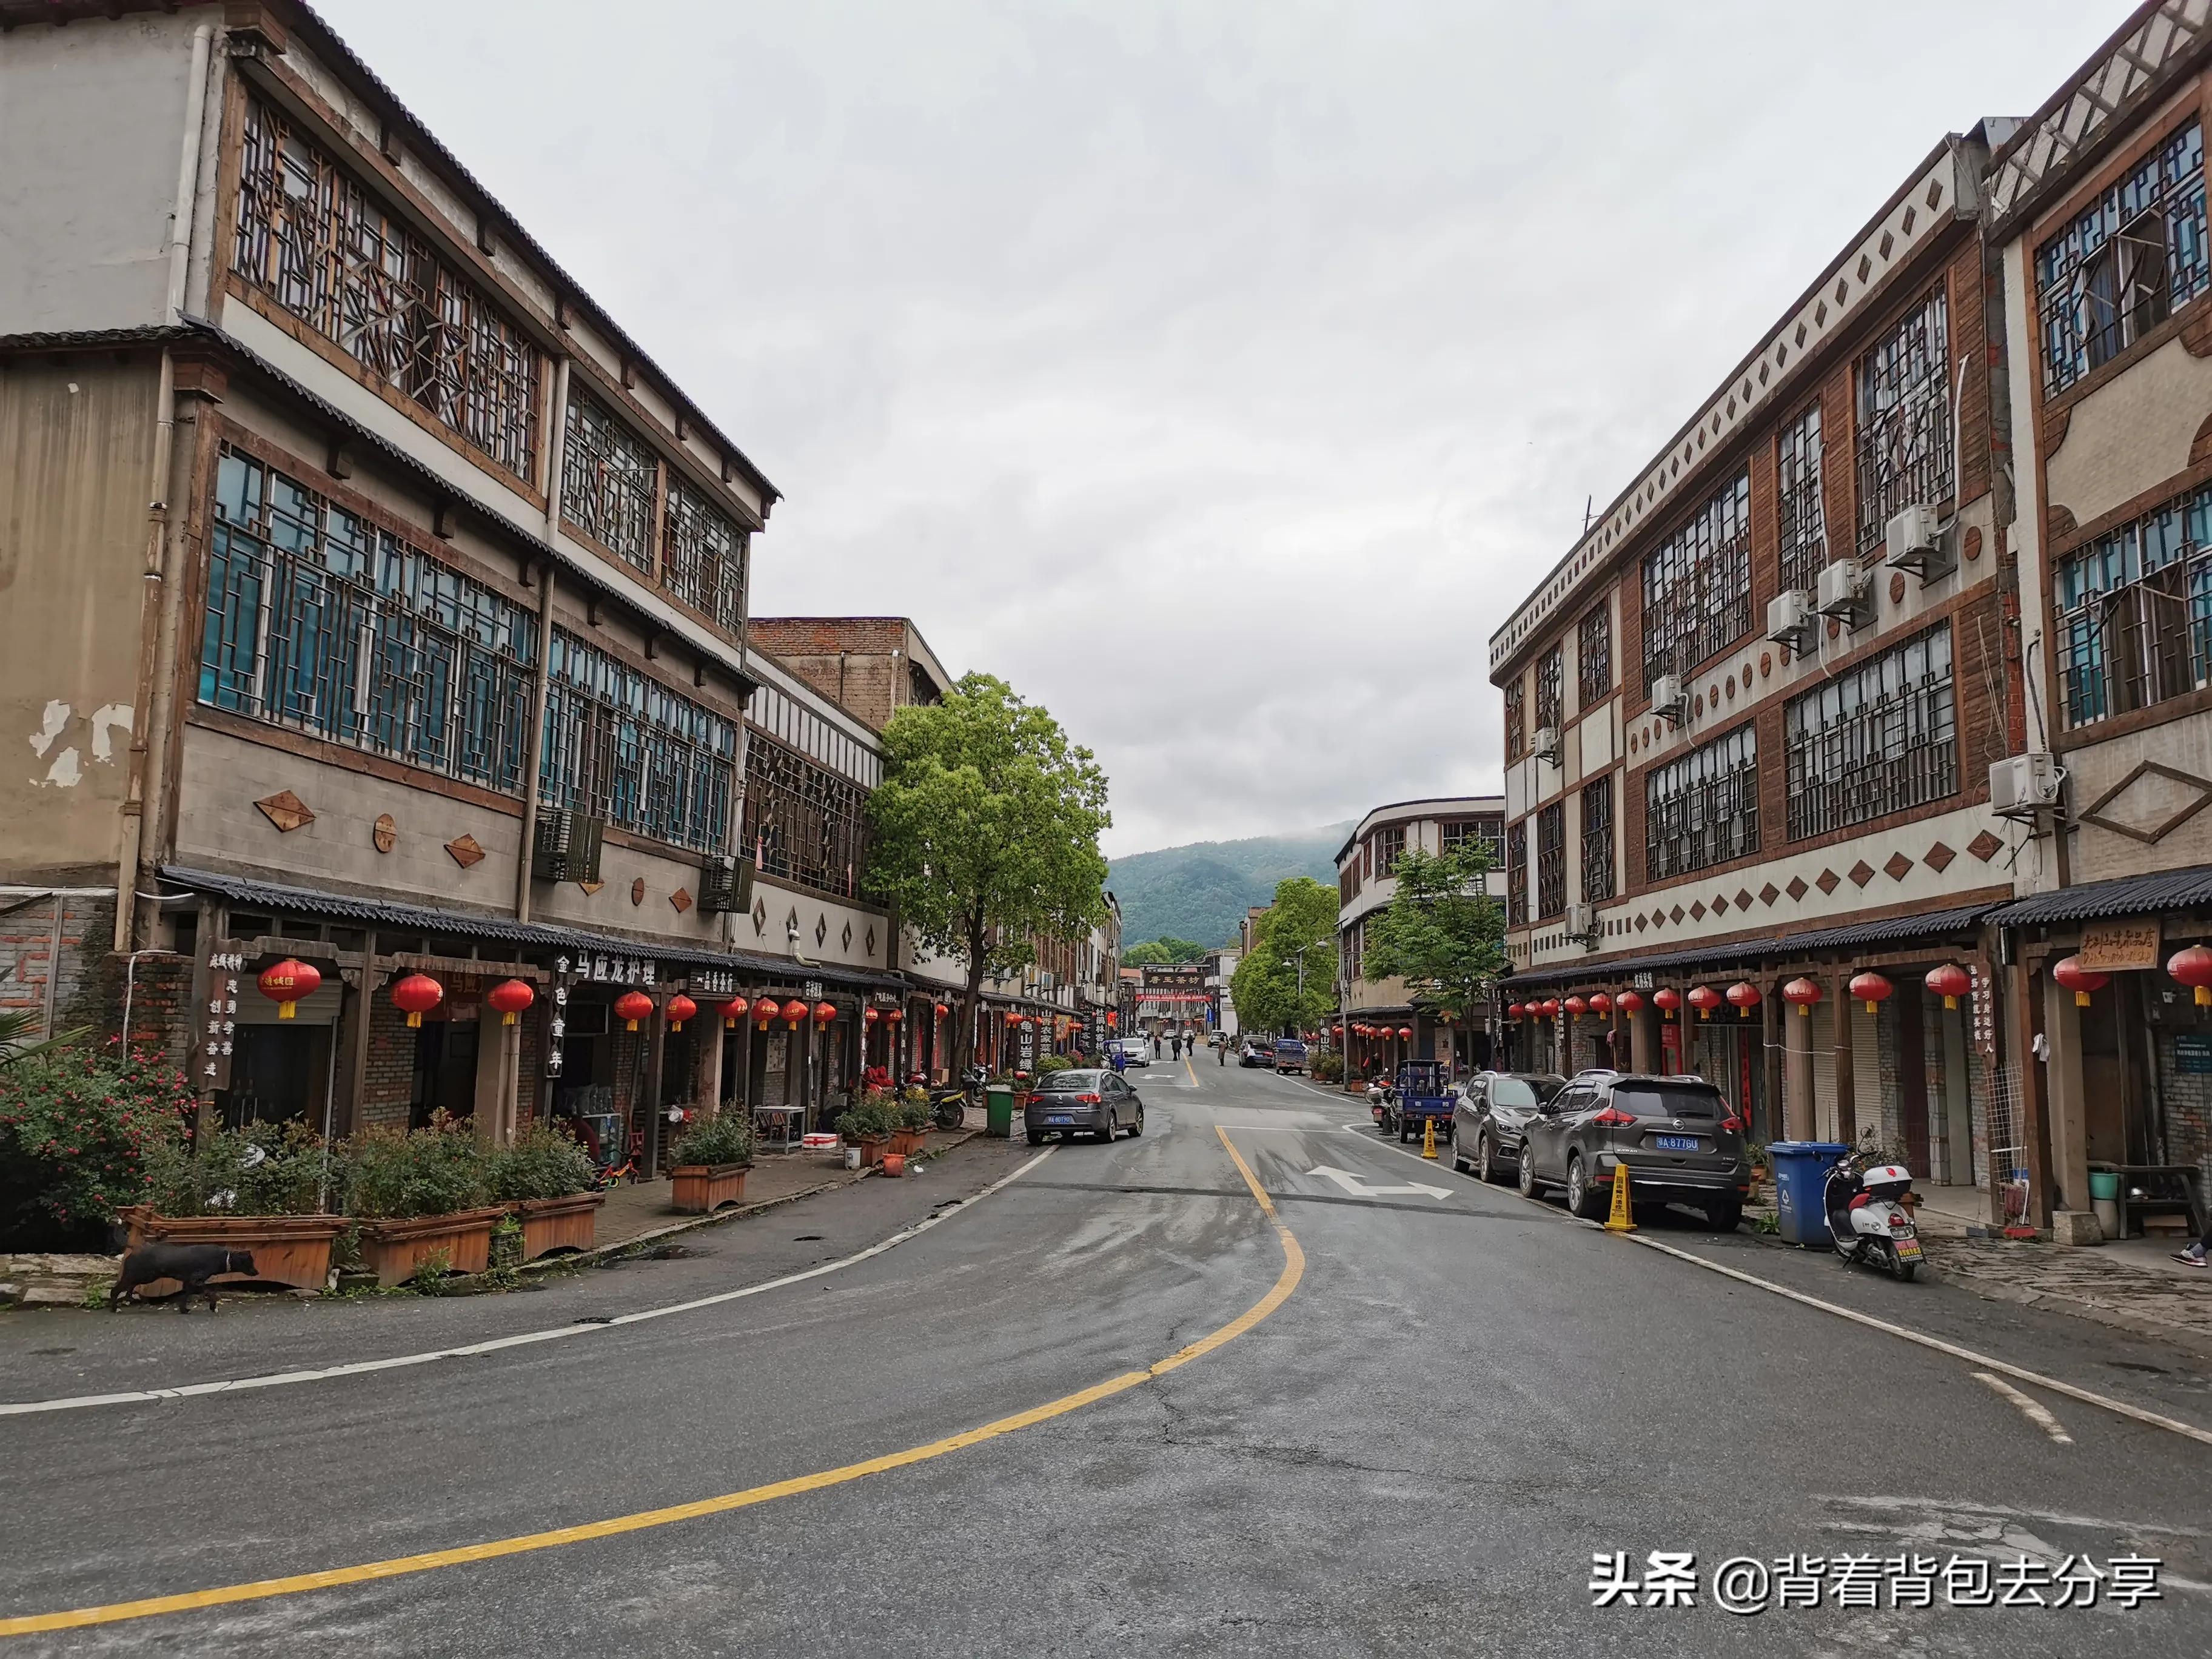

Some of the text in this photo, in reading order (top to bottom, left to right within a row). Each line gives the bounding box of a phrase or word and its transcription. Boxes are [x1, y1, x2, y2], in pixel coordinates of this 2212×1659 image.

[576, 950, 659, 985] 马应龙护理
[203, 999, 221, 1076] 创新奋进
[221, 979, 238, 1056] 忠勇孝善
[549, 955, 570, 1070] 金色童年
[1019, 1021, 1033, 1070] 龟山岩绿
[1981, 977, 1994, 1053] 学习身边好人
